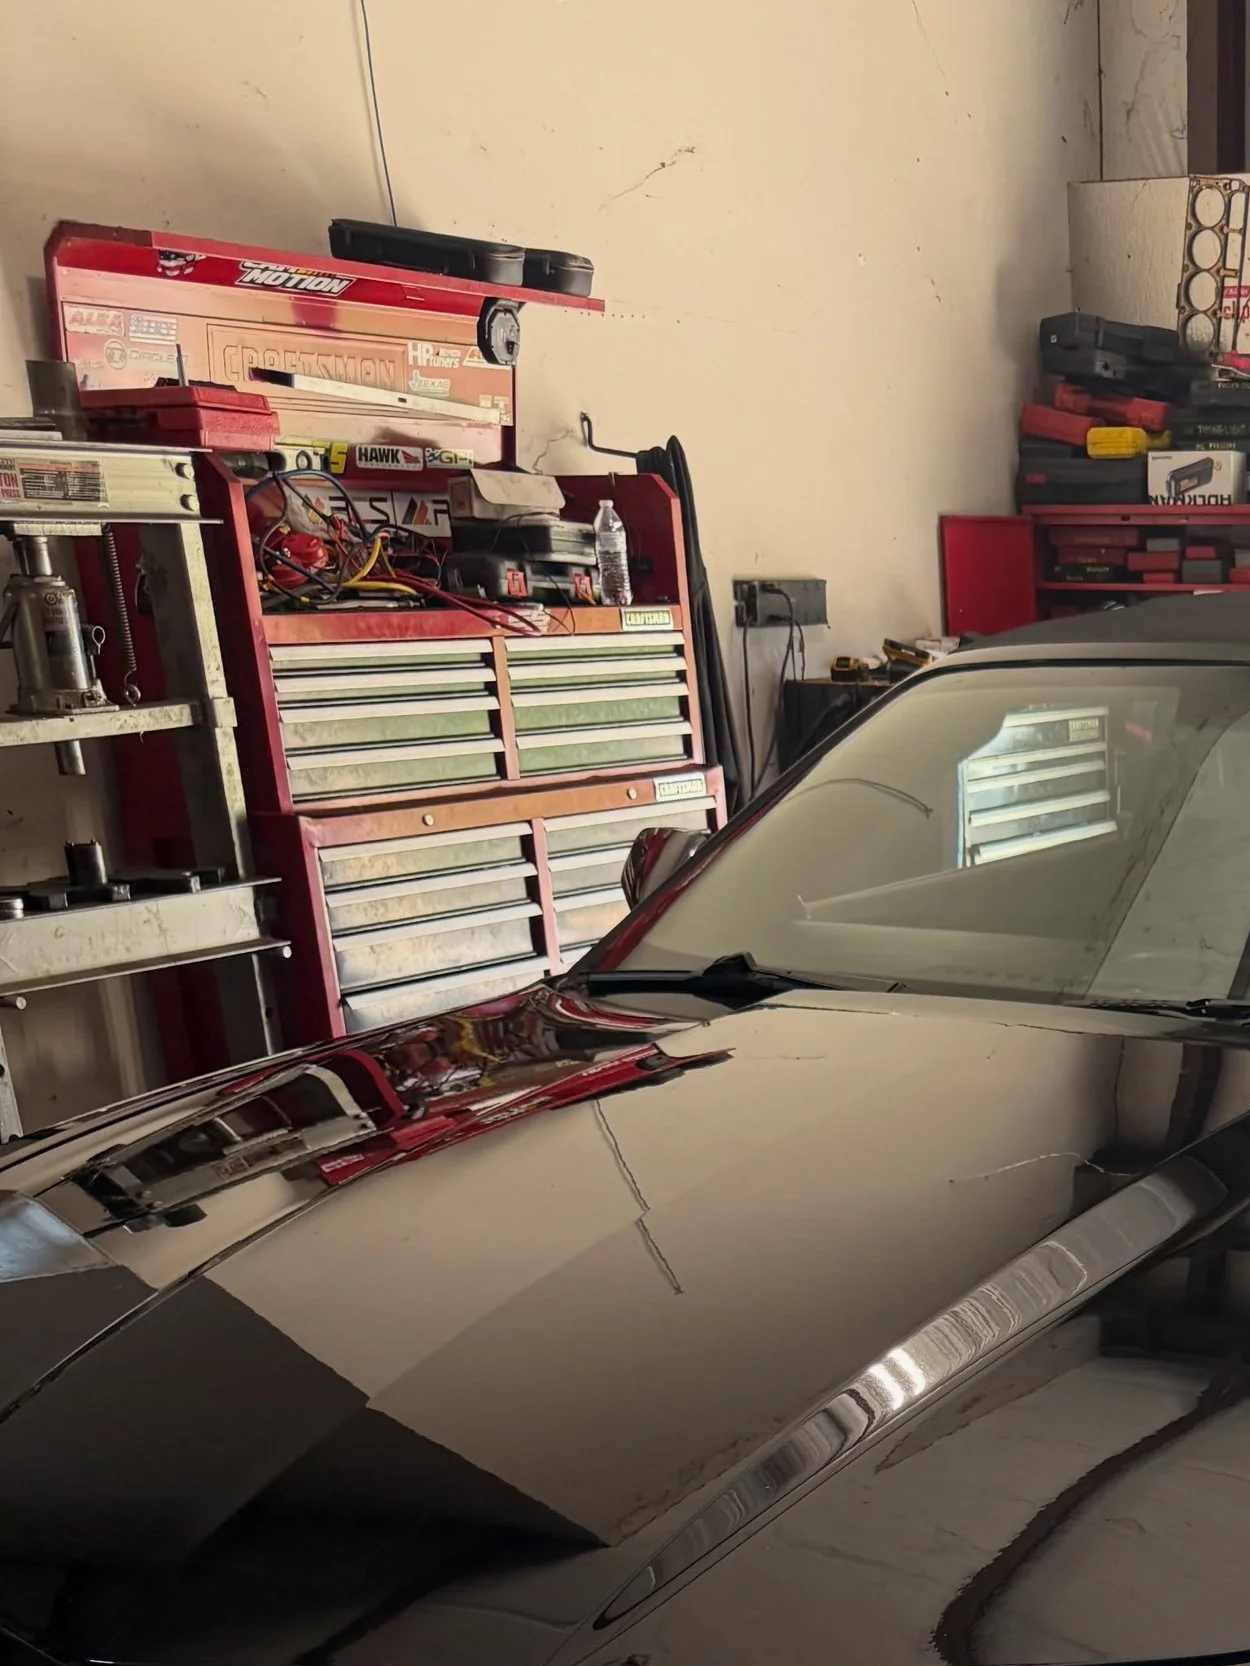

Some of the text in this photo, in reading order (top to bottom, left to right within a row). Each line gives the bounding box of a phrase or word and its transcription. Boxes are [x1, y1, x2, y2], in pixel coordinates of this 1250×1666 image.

[242, 268, 350, 294] MOTION
[222, 343, 396, 388] CRAFTSMAN
[358, 446, 400, 464] HAWK
[625, 611, 670, 626] CRAFTSMAN
